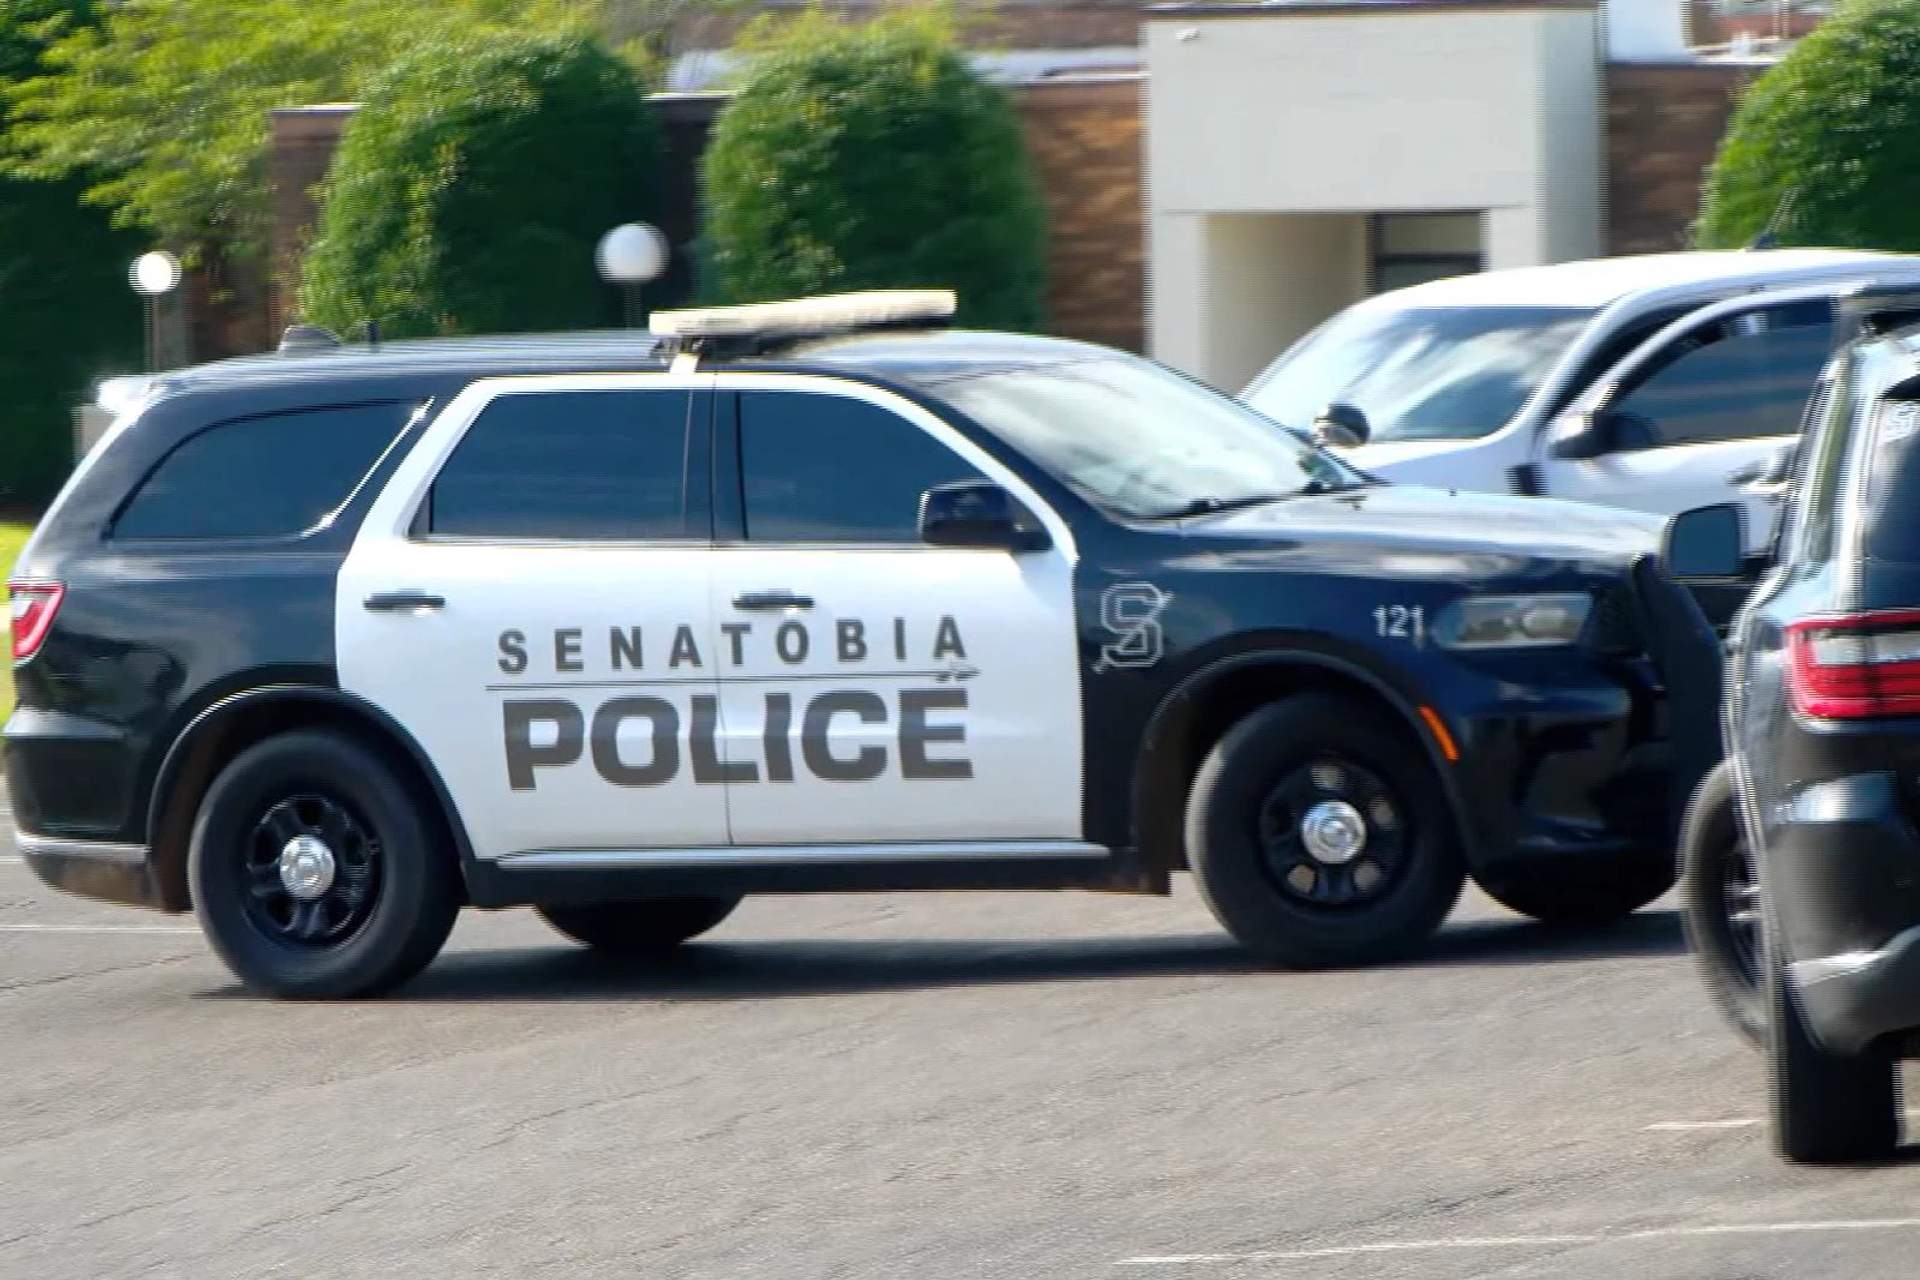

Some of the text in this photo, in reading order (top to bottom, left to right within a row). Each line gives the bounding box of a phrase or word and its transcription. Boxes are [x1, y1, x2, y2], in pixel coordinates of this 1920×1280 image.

[497, 614, 968, 674] SENATOBIA
[1371, 604, 1424, 643] 121
[502, 688, 974, 790] POLICE
